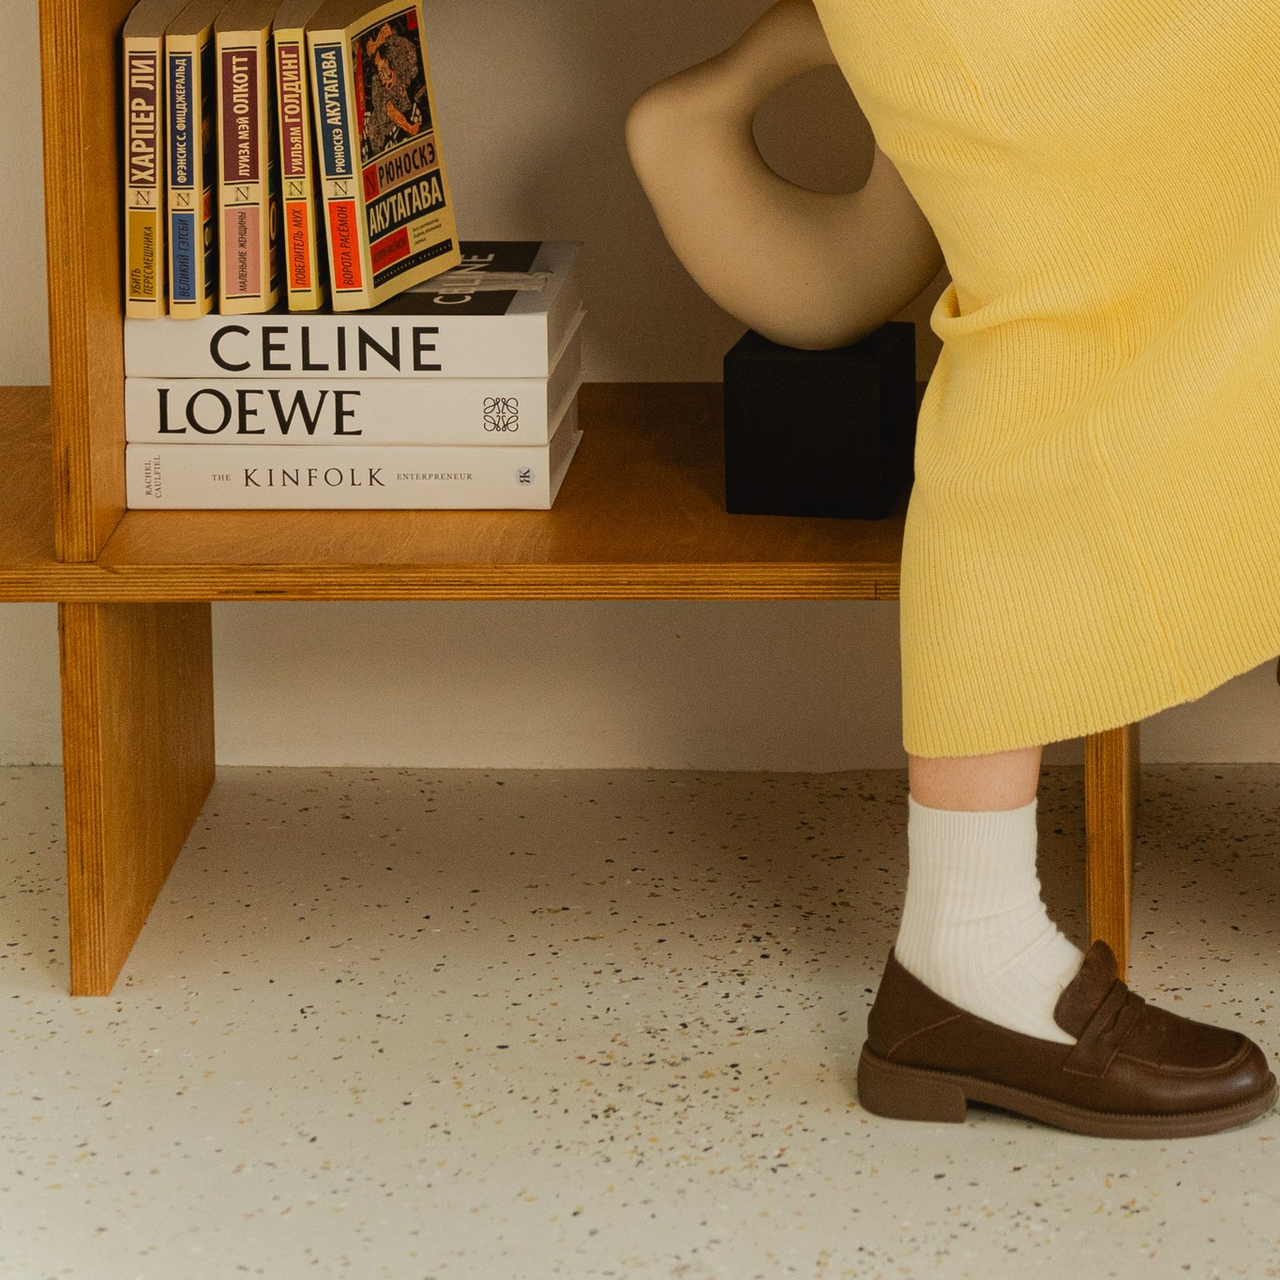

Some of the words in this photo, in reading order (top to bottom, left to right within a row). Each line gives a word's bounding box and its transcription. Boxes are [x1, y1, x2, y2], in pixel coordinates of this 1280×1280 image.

[130, 58, 155, 90] ЛИ
[174, 58, 188, 131] ФИЦДЖЕРАЛЬД
[232, 55, 249, 116] ОЛКОТТ
[282, 50, 302, 124] ГОЛДИНГ
[320, 50, 339, 126] АКУТАГАВА
[131, 97, 155, 183] ХАРПЕР
[177, 132, 187, 144] С.
[237, 116, 250, 140] МЭЙ
[291, 126, 304, 173] УИЛЬЯМ
[176, 145, 188, 184] ФРЭНСИС
[238, 142, 250, 177] ЛУИЗА
[335, 128, 346, 173] РЮНОСКЭ
[378, 143, 436, 189] РЮНОСКЭ
[293, 208, 305, 228] МУХ
[339, 205, 352, 248] РАСЁМОН
[369, 176, 442, 238] АКУТАГАВА
[180, 218, 190, 250] ГЭТСБИ
[239, 211, 248, 248] ЖЕНЩИНЫ
[142, 226, 154, 296] ПЕРЕСМЕШНИКА
[178, 254, 190, 298] ВЕЛИКИЙ
[240, 250, 248, 292] МАЛЕНЬКИЕ
[294, 228, 306, 286] ПОВЕЛИТЕЛЬ
[342, 250, 354, 286] ВОРОТА
[131, 268, 142, 295] УБИТЬ
[210, 324, 442, 372] CELINE
[157, 388, 362, 435] LOEWE
[244, 468, 386, 488] KINFOLK
[396, 472, 473, 480] ENTERPRENEUR
